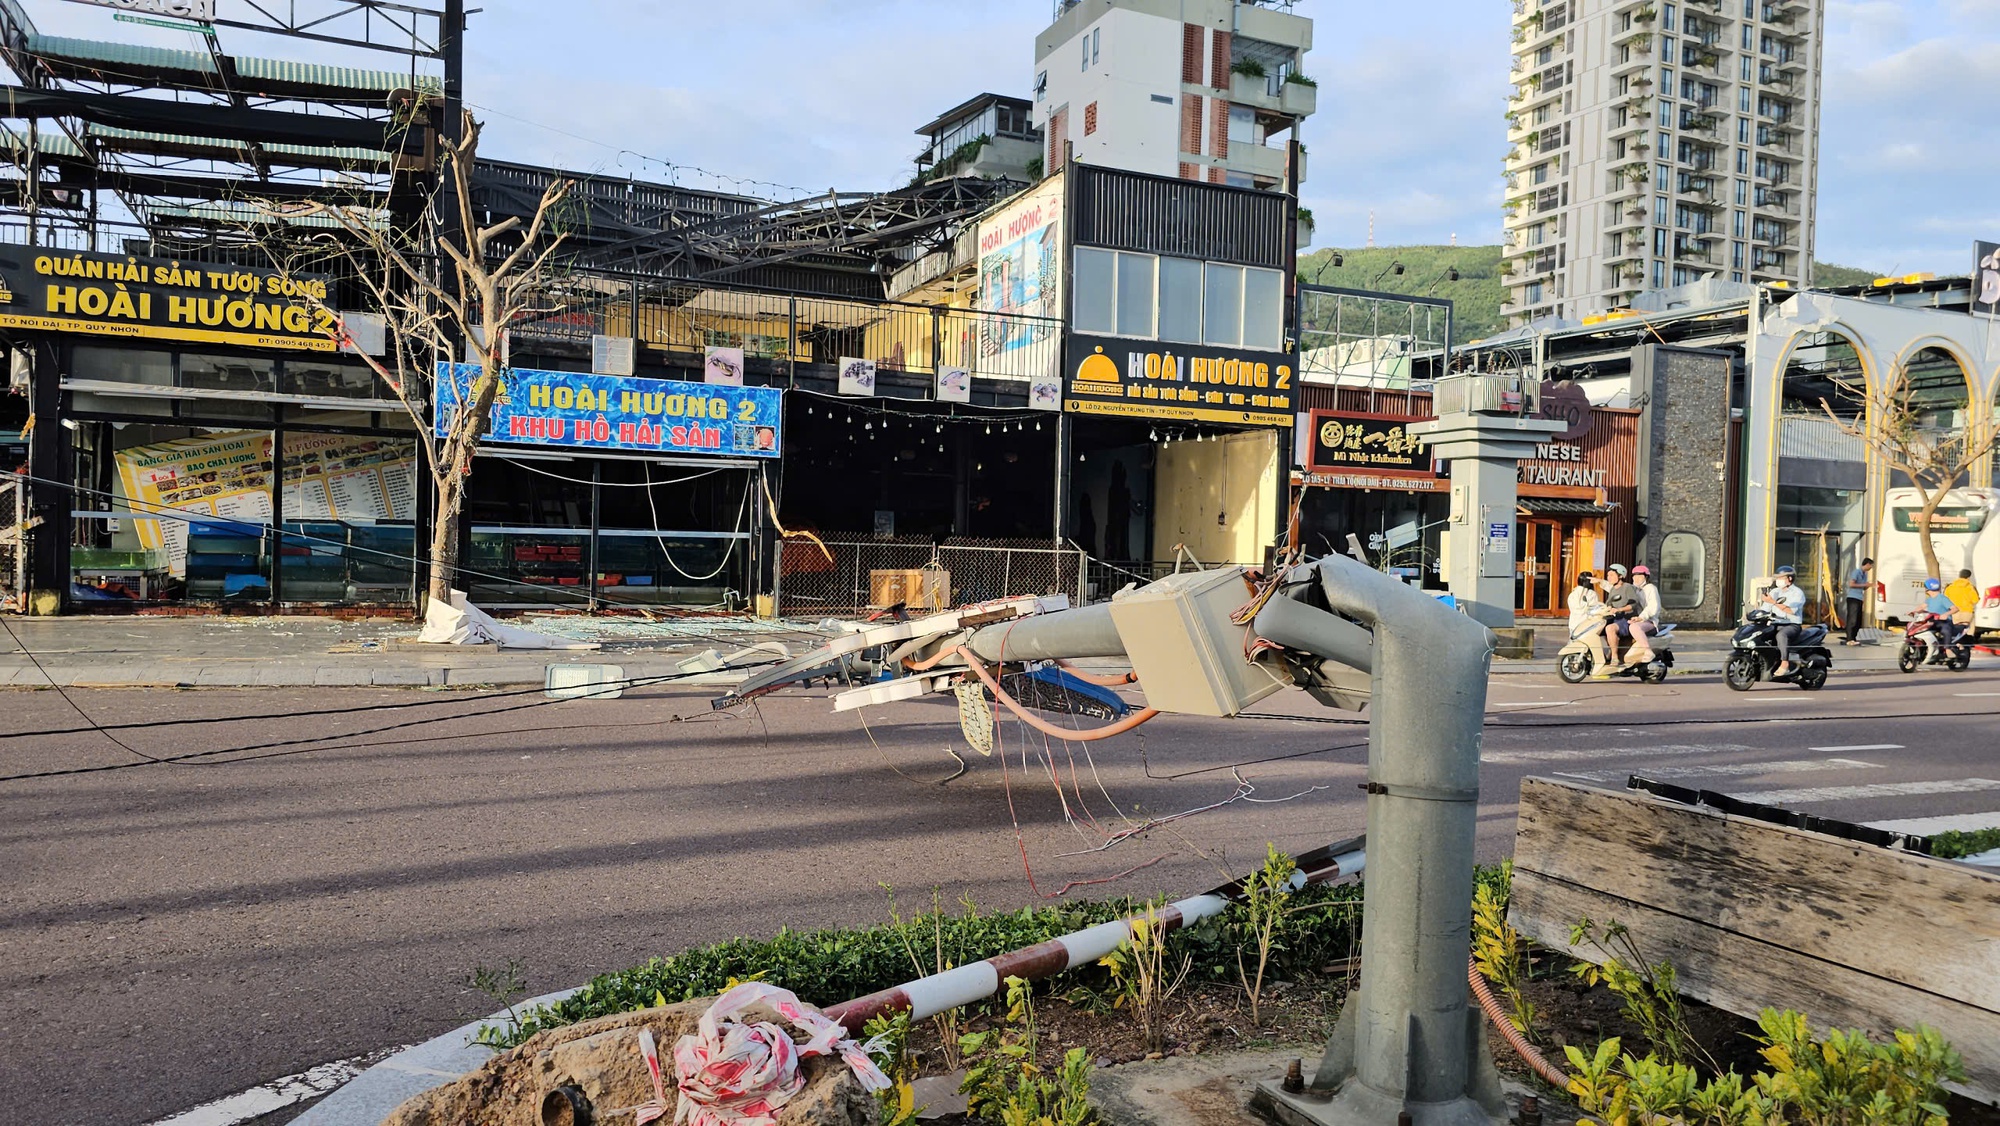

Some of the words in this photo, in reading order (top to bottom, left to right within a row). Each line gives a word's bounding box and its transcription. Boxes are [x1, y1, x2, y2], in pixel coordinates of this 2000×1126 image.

[981, 225, 1003, 253] HOÀI
[1048, 197, 1059, 219] 2
[34, 253, 103, 278] QUÁN
[107, 256, 149, 283] HẢI
[153, 260, 201, 288] SẢN
[207, 270, 260, 293] TƯƠI
[46, 282, 151, 320] HOÀI
[168, 294, 310, 333] HƯƠNG
[313, 308, 335, 335] 2
[85, 323, 107, 332] QUY
[274, 339, 296, 347] 0905
[1127, 350, 1185, 382] HOÀI
[1190, 356, 1270, 389] HƯƠNG
[1275, 364, 1292, 390] 2
[529, 383, 608, 412] HOÀI
[621, 391, 728, 419] HƯƠNG
[738, 400, 756, 421] 2
[509, 416, 564, 440] KHU
[575, 413, 610, 443] HỒ
[619, 419, 662, 445] HẢI
[671, 420, 722, 448] SẢN
[1536, 443, 1581, 461] NESE
[1526, 466, 1607, 487] TAURANT
